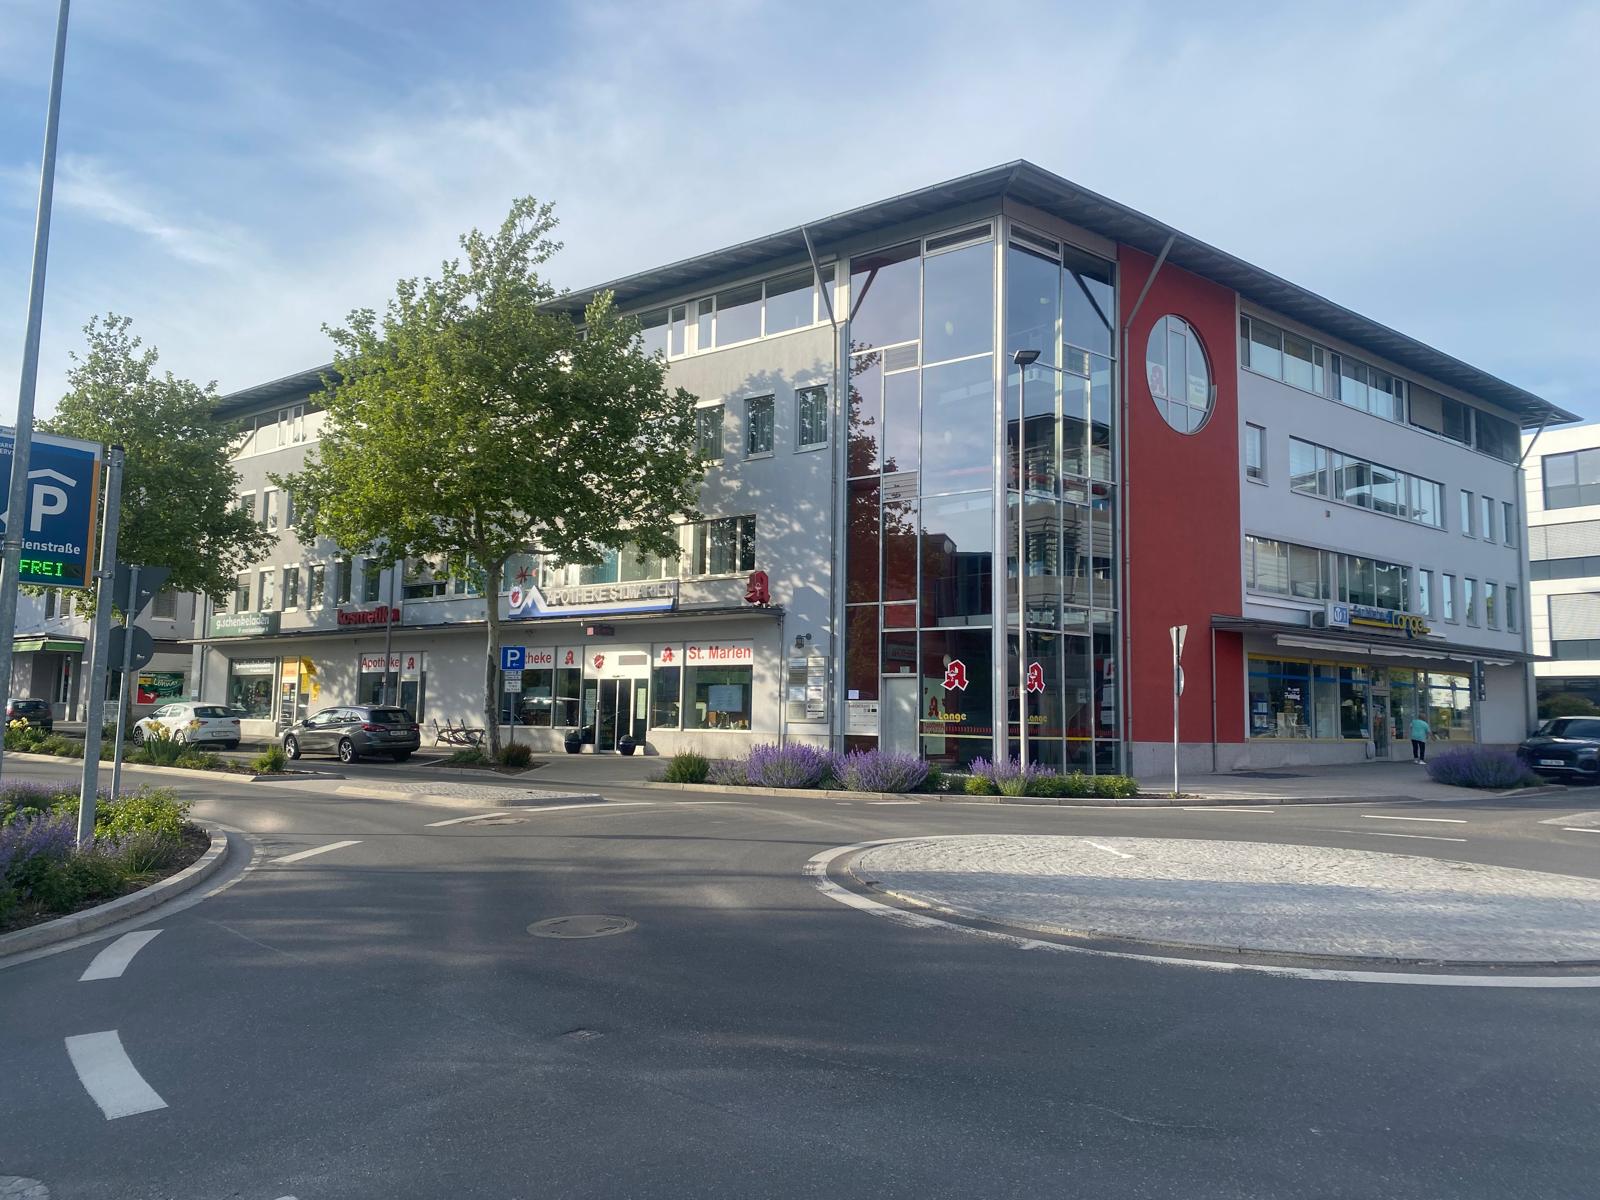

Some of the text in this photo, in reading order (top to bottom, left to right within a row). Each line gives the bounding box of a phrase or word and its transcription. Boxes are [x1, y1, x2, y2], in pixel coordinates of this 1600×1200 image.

[30, 484, 68, 532] P
[21, 538, 81, 554] ienstraße
[19, 559, 63, 577] FREI
[507, 649, 520, 667] P
[525, 651, 552, 664] heke
[688, 645, 751, 660] St. Marien
[362, 656, 400, 669] Apothke
[1027, 715, 1049, 724] ange
